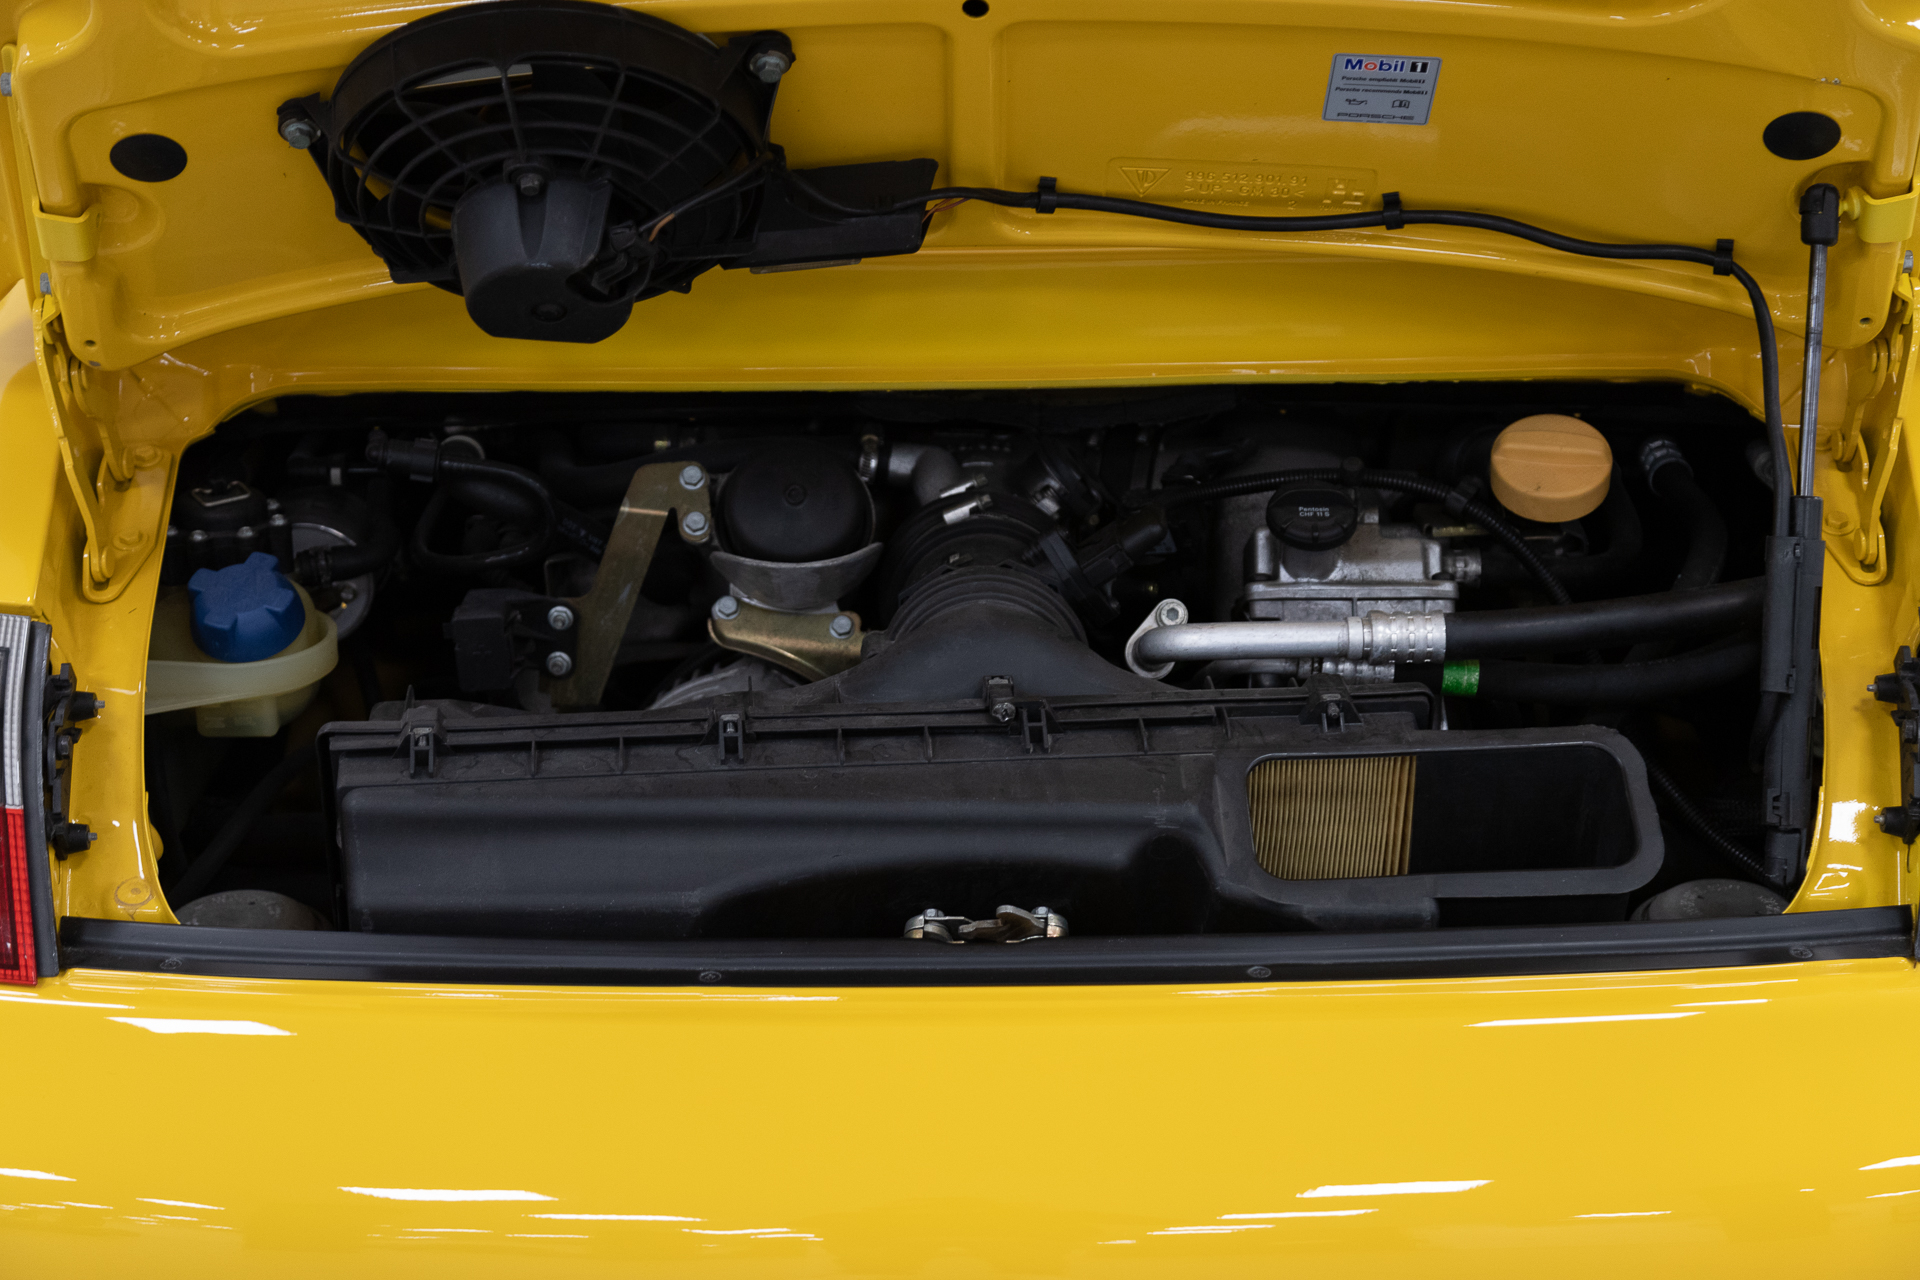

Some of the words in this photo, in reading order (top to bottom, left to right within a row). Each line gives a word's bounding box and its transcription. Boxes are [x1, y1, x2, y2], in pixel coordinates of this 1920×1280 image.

[1344, 58, 1405, 72] Mobil
[1411, 61, 1427, 73] 1
[1337, 112, 1414, 120] PORSCHE
